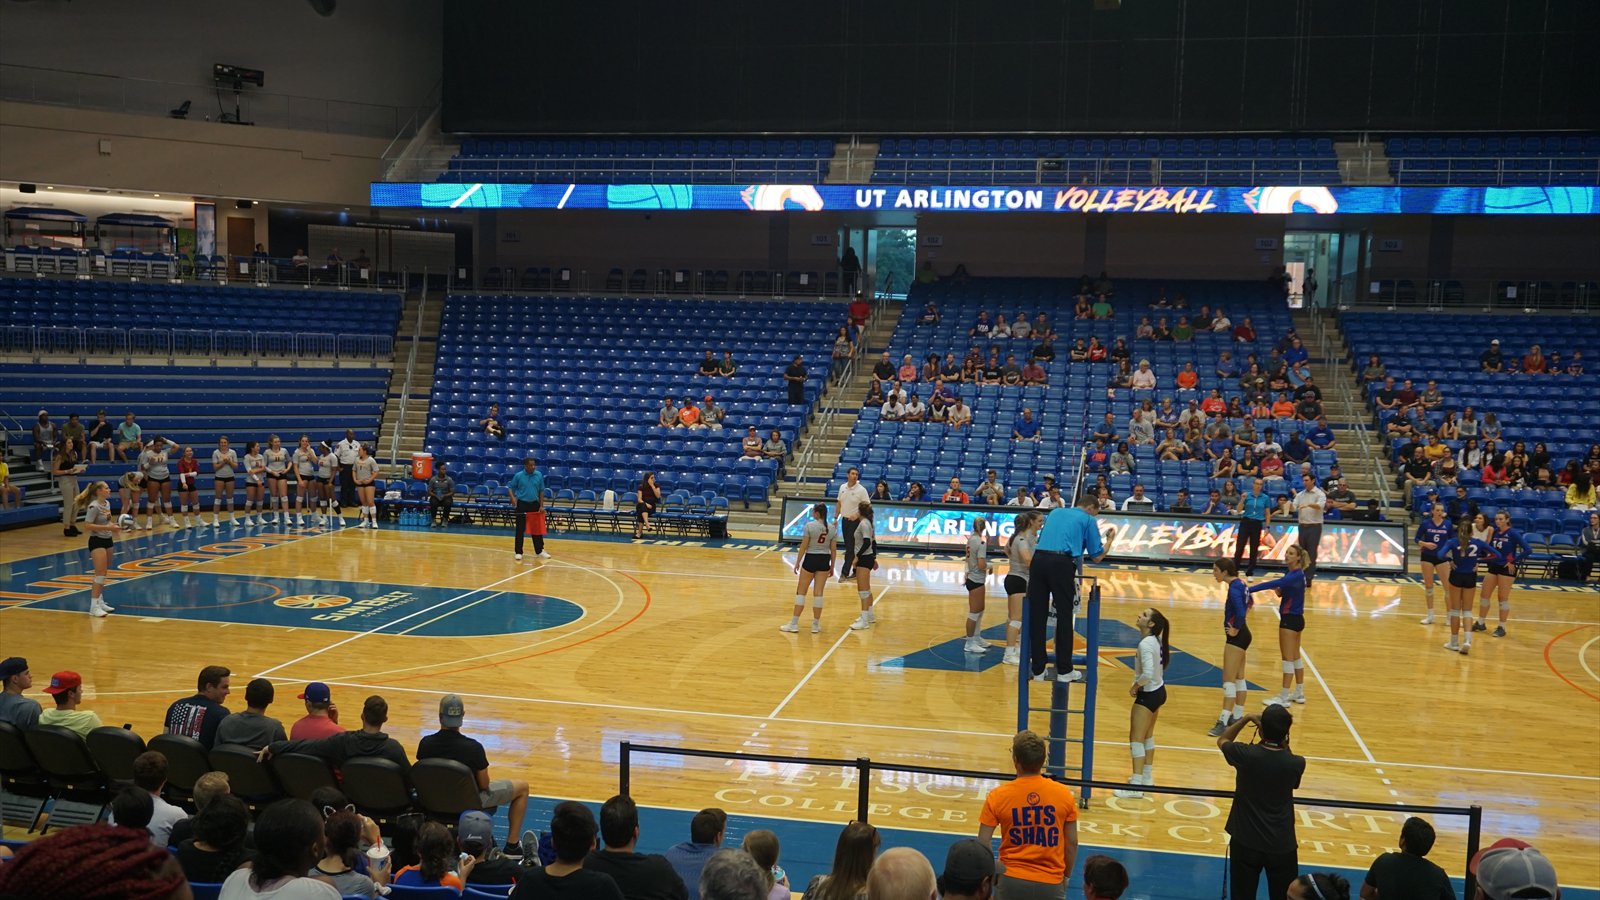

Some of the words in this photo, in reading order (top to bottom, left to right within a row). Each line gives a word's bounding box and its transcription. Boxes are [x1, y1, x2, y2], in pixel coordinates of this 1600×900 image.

[855, 189, 887, 208] UT
[894, 189, 1043, 210] ARLINGTON
[1053, 186, 1218, 213] VOLLEYBALL
[631, 538, 707, 547] THE
[817, 533, 827, 544] 6
[887, 516, 918, 533] UT
[920, 518, 1041, 538] ARLNG
[1096, 517, 1272, 553] OLLEYBA
[1433, 534, 1440, 543] 6
[1492, 540, 1503, 550] 14
[0, 533, 316, 606] LINGTON
[713, 787, 969, 823] COLLEGE
[727, 763, 996, 801] PETSC
[1104, 795, 1392, 835] CORT
[1011, 805, 1056, 827] LETS
[1008, 826, 1060, 848] SHAG
